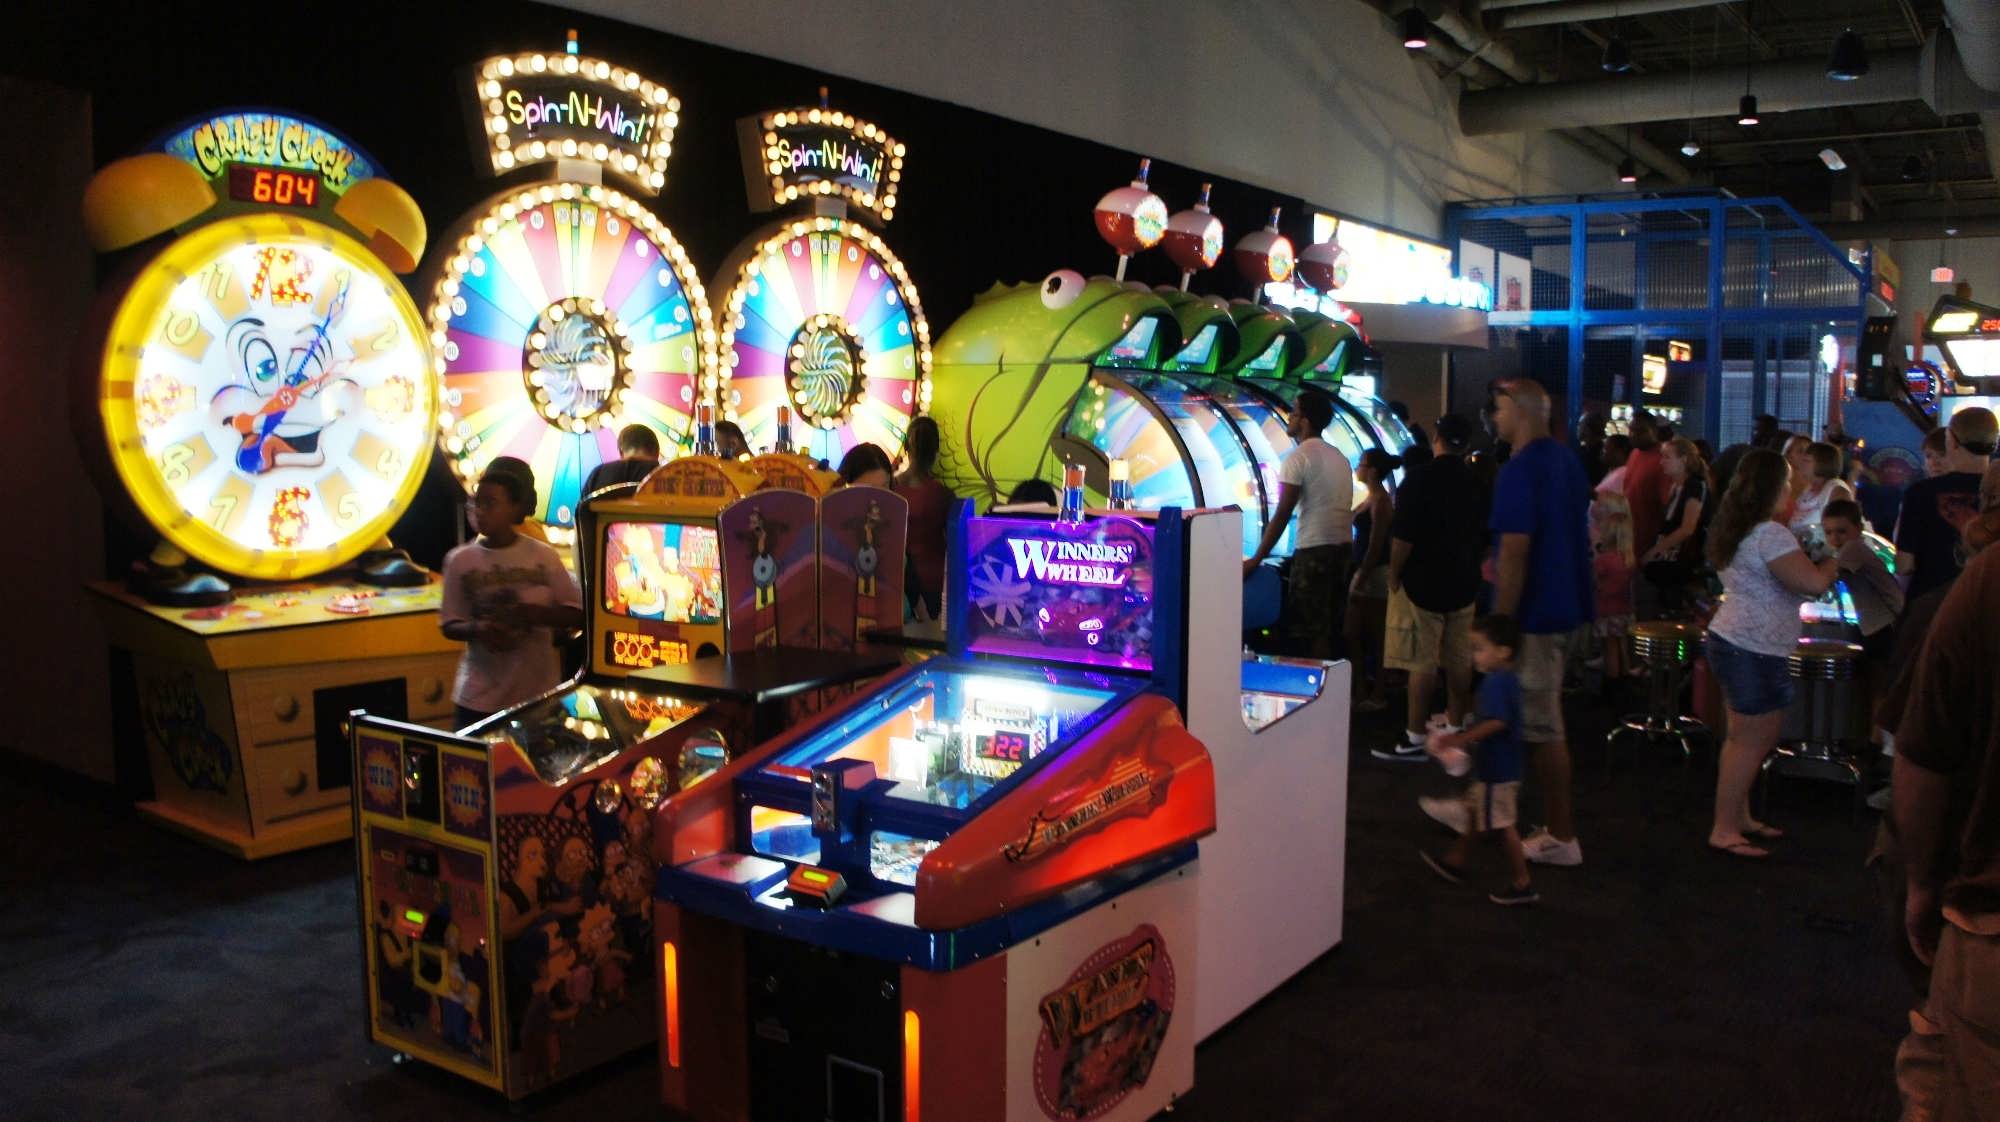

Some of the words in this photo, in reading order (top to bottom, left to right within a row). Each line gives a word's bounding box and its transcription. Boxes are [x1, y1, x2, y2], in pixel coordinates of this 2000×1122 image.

[506, 90, 646, 143] Spin-N-Win!
[193, 115, 280, 176] CRAZY
[280, 122, 355, 185] CLOCK
[778, 138, 878, 183] Spin-N-Win!
[253, 171, 315, 205] 604
[1008, 538, 1134, 580] WINNERS'
[1045, 563, 1126, 585] WHEEL
